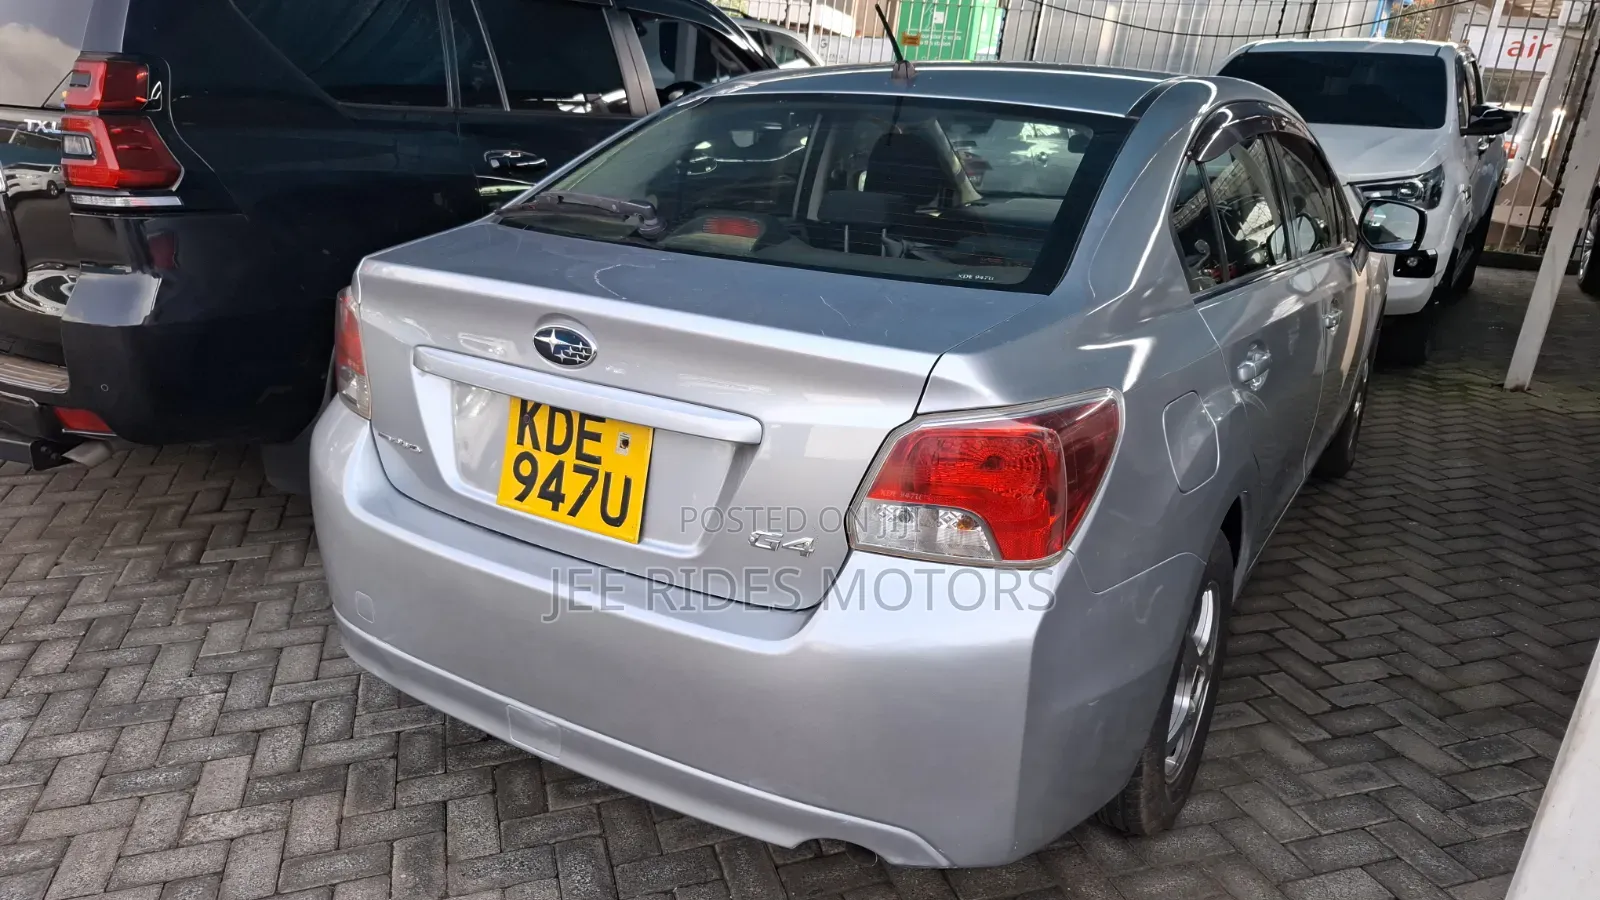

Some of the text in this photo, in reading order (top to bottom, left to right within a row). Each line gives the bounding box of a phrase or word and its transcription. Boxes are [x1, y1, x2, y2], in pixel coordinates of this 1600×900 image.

[1507, 35, 1553, 60] air
[516, 399, 607, 466] KDE
[512, 450, 633, 528] 947U
[747, 530, 817, 558] G4
